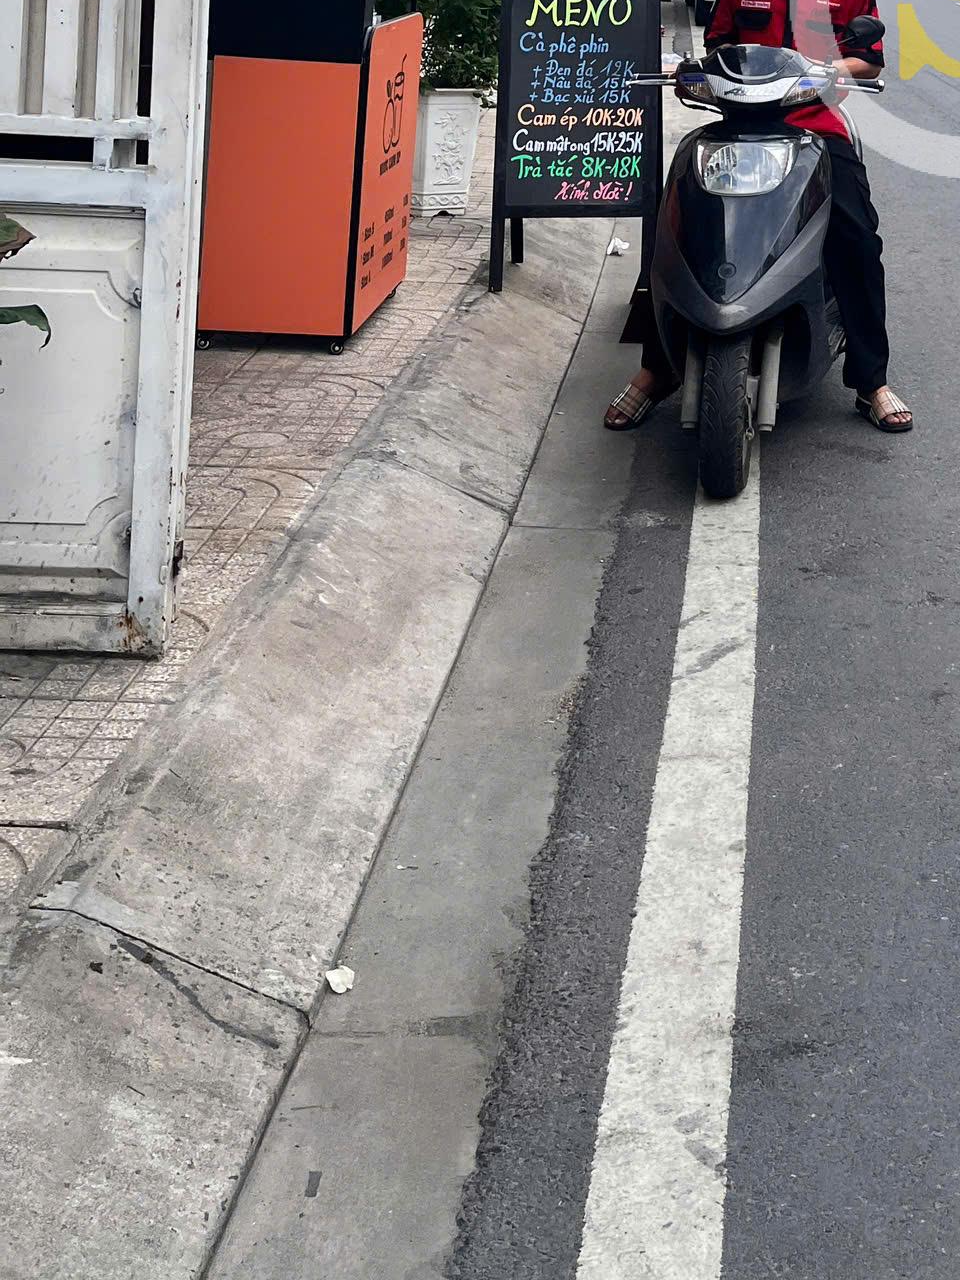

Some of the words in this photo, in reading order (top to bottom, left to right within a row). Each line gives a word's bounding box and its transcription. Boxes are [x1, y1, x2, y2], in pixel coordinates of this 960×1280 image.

[519, 31, 546, 53] Cà
[548, 31, 577, 58] phê
[579, 33, 609, 59] phin
[545, 59, 571, 77] Đen
[576, 59, 597, 77] đá
[600, 59, 635, 77] 12K
[543, 76, 571, 89] Nâu
[575, 76, 599, 89] đá
[541, 89, 571, 105] Bạc
[598, 89, 631, 104] 15K
[516, 103, 556, 126] Cam
[560, 107, 578, 131] ép
[582, 107, 644, 127] 10K-20K
[512, 128, 546, 153] Cam
[545, 135, 571, 156] mật
[570, 143, 591, 156] ong
[590, 131, 644, 154] 15K-25K
[510, 154, 543, 179] Trà
[547, 154, 578, 177] tắc
[581, 155, 642, 179] 8K-18K
[554, 179, 591, 200] Kính
